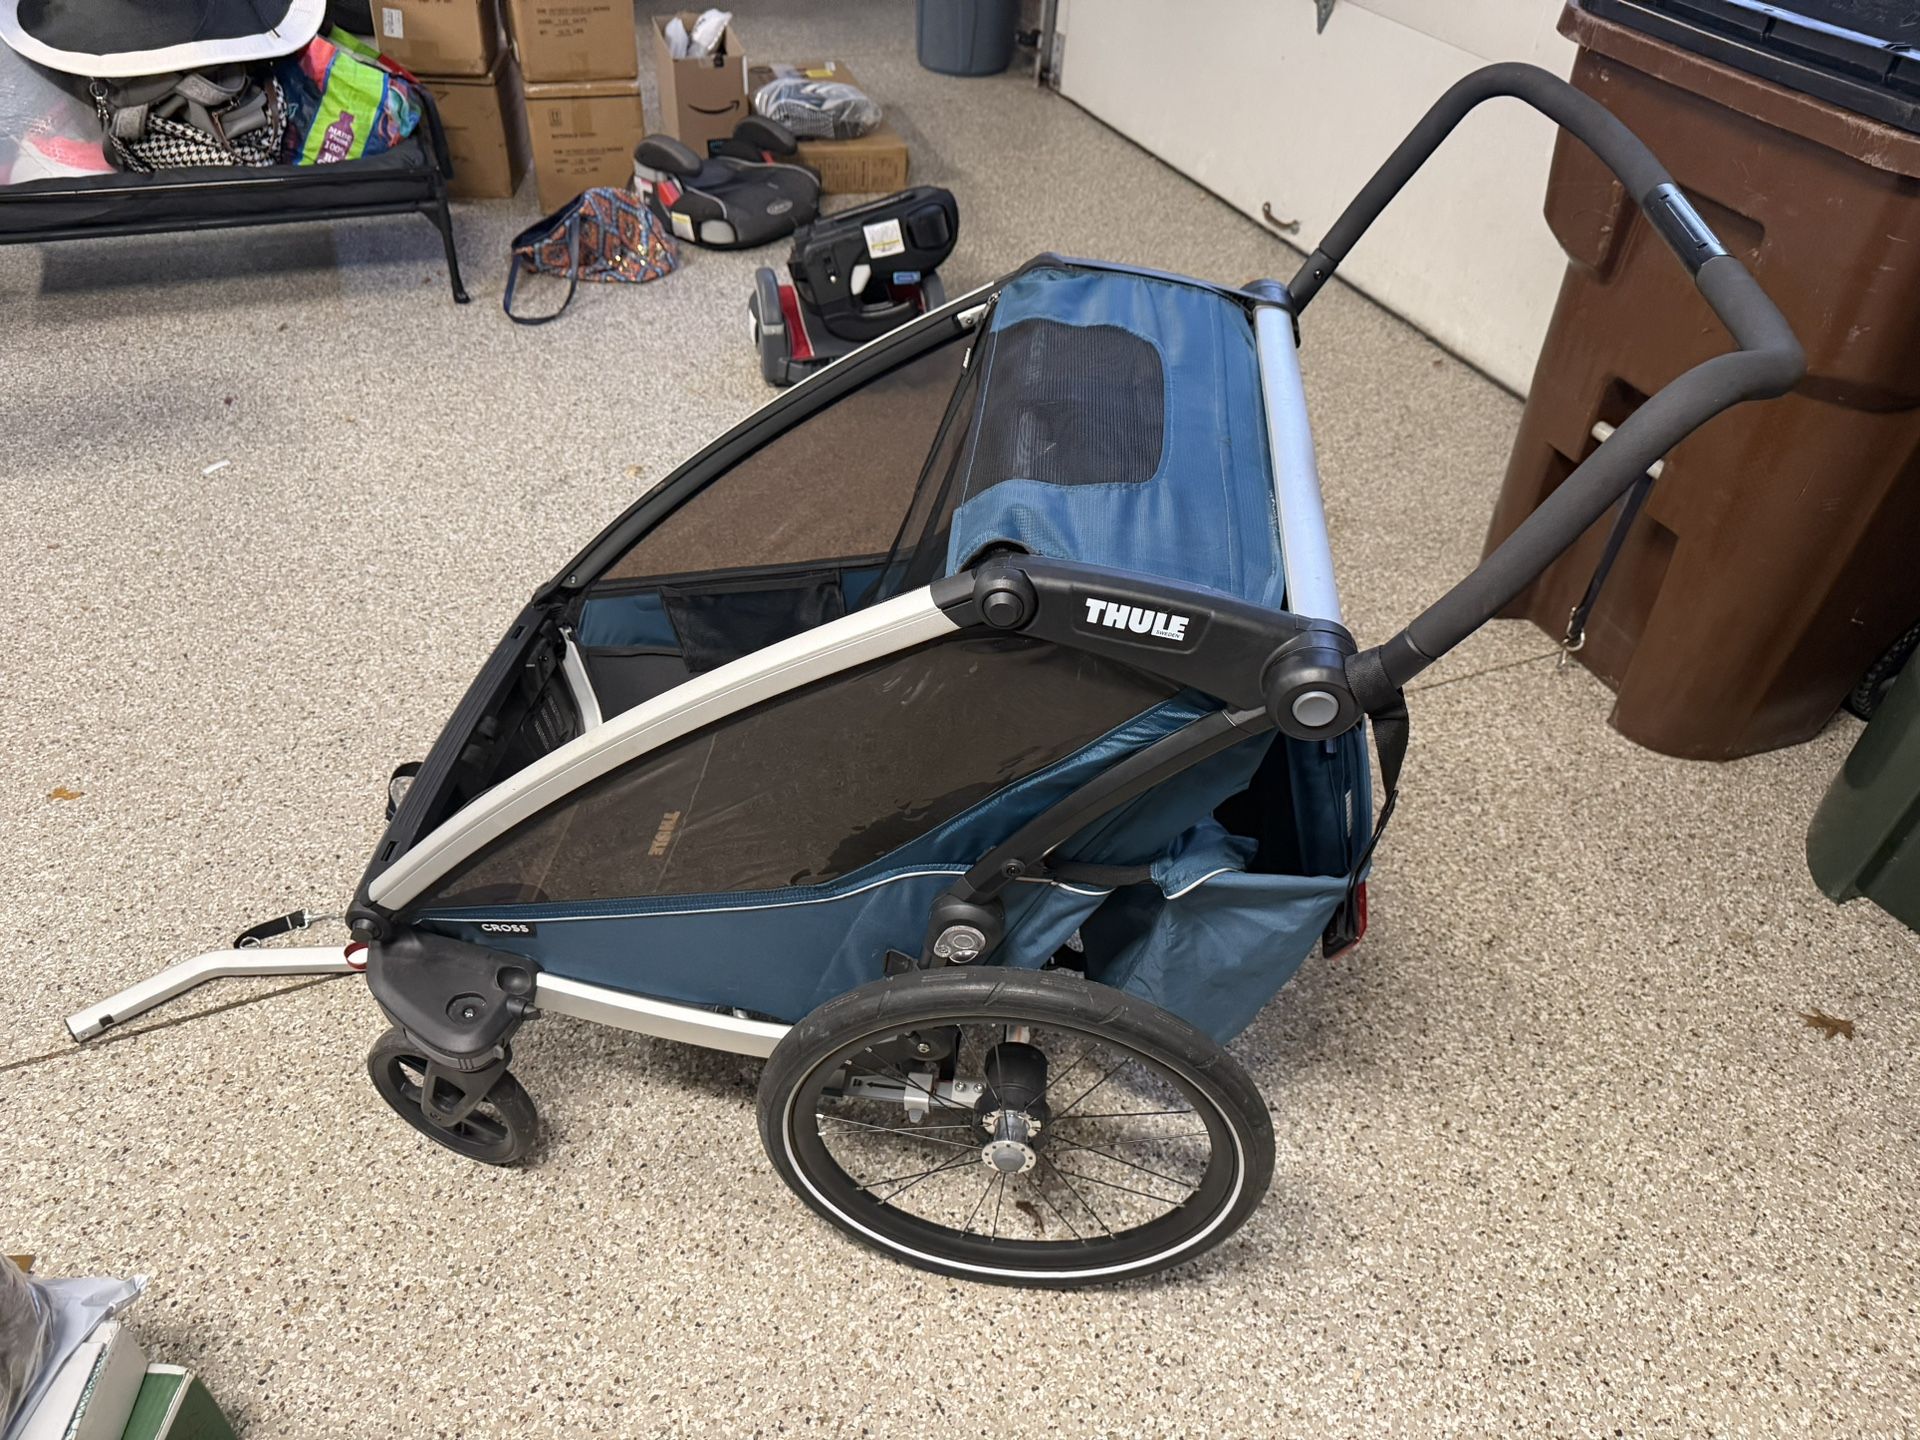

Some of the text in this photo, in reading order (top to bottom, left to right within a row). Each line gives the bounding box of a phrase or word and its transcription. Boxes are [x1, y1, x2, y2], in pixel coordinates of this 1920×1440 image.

[1085, 597, 1190, 642] THULE
[1155, 629, 1181, 639] SWEDEN
[647, 811, 681, 856] THULE
[481, 923, 529, 933] CROSS
